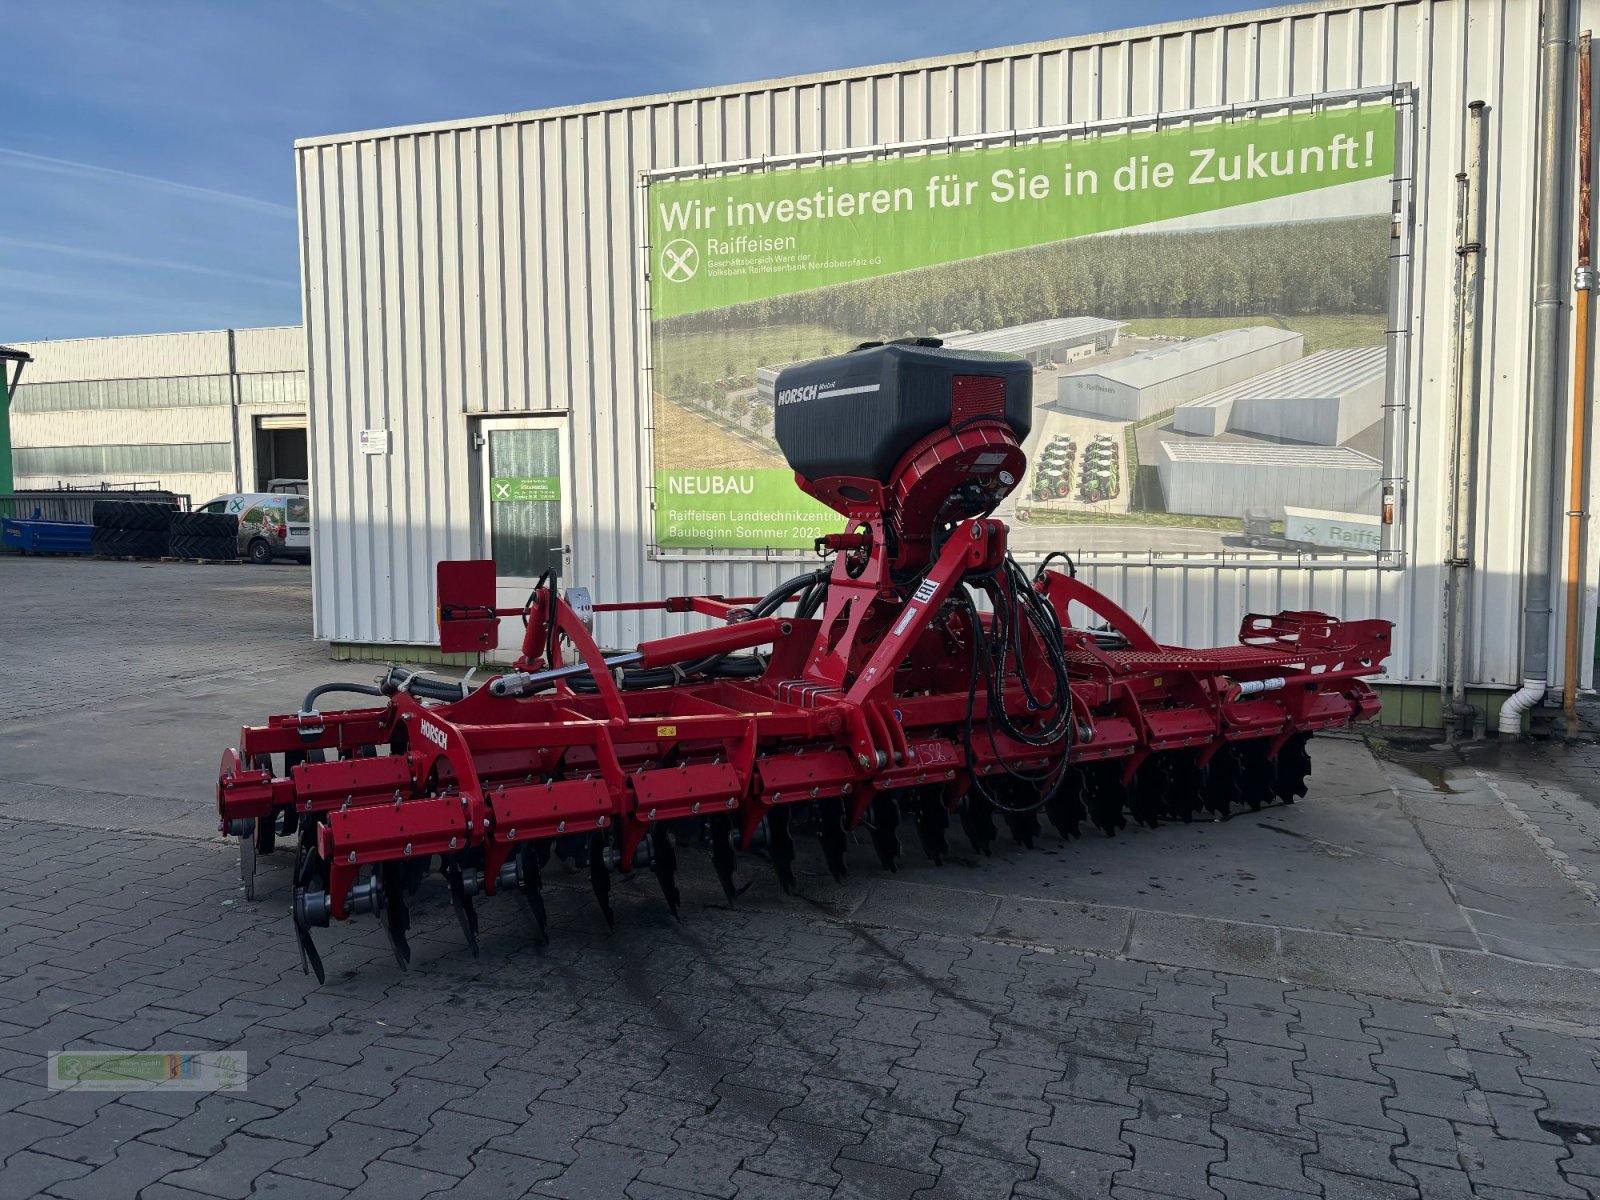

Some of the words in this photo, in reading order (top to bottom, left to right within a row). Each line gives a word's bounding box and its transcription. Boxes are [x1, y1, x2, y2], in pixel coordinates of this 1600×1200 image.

[660, 200, 716, 232] Wir
[727, 186, 913, 227] investieren
[926, 175, 979, 209] für
[990, 167, 1050, 203] Sie
[1064, 163, 1098, 196] in
[1113, 155, 1174, 192] die
[1188, 130, 1375, 185] Zukunft!
[707, 235, 796, 255] Raiffeisen
[707, 256, 773, 268] Geschäftsbereich
[775, 254, 796, 264] Ware
[797, 253, 811, 262] der
[707, 264, 747, 277] Volksbank
[749, 260, 806, 274] Raiffeisenbank
[808, 257, 867, 270] Nordoberpfalz
[869, 256, 881, 265] eG
[778, 384, 818, 406] HORSCH
[669, 475, 754, 495] NEUBAU
[669, 509, 726, 521] Raiffeisen
[669, 526, 732, 539] Baubeginn
[736, 526, 788, 538] Sommer
[792, 527, 821, 538] 2023
[420, 718, 448, 750] HORSCH
